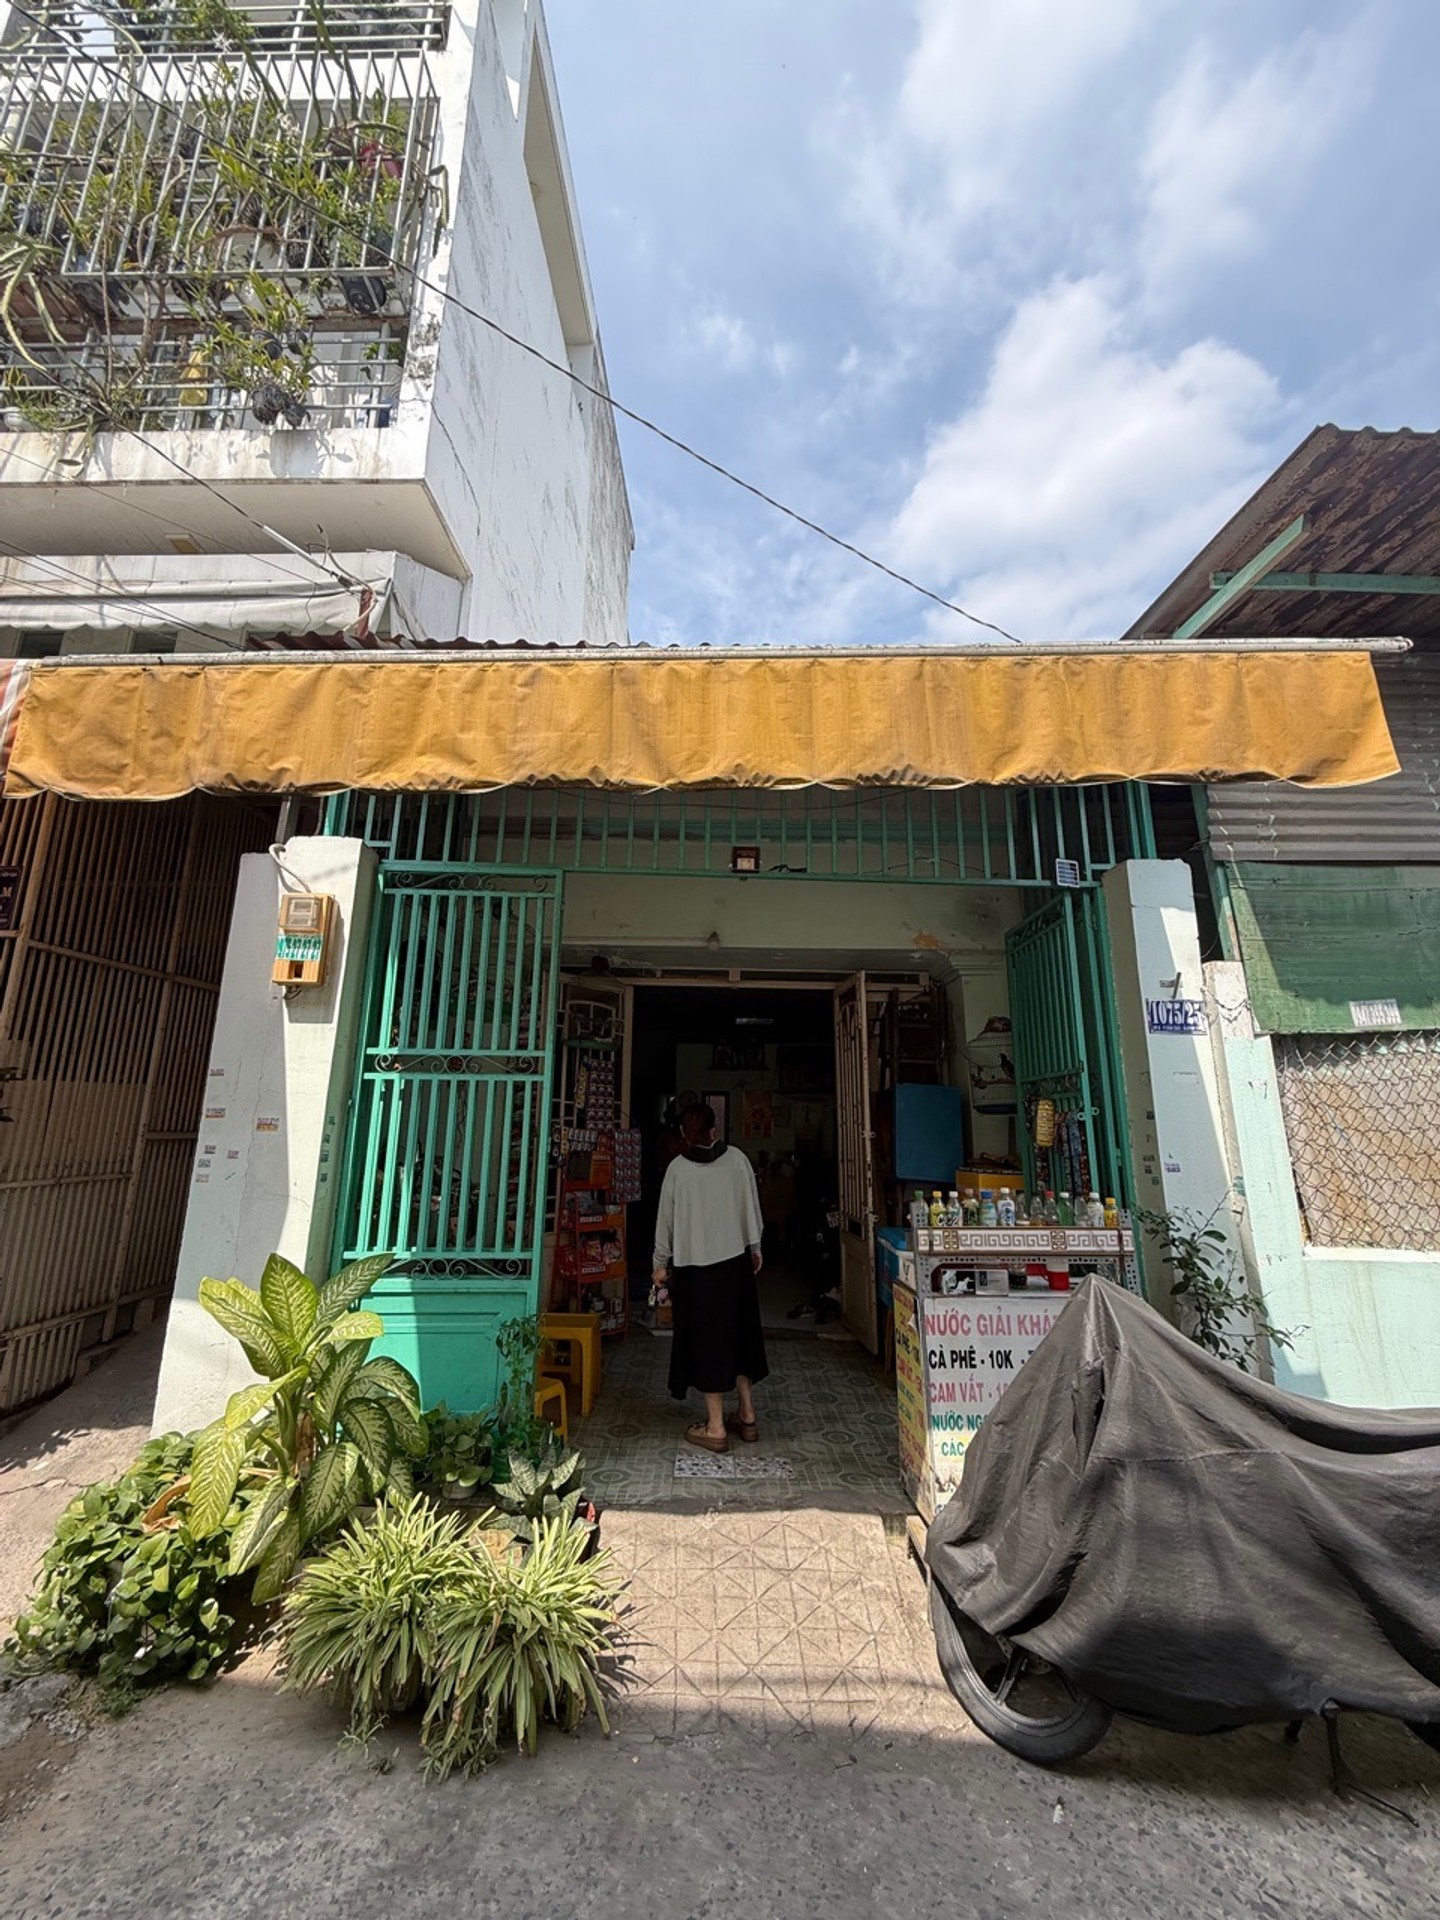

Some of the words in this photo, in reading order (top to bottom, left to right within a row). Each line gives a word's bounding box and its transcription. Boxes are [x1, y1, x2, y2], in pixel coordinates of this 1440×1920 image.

[925, 1307, 971, 1336] NƯỚC
[977, 1306, 1012, 1336] GIẢI
[1018, 1309, 1058, 1336] KHÁ
[928, 1344, 947, 1369] CÀ
[950, 1345, 977, 1369] PHÊ
[988, 1350, 1014, 1369] 10K
[928, 1382, 957, 1403] CAM
[932, 1410, 964, 1431] NƯỚC
[967, 1414, 988, 1431] NG
[941, 1438, 964, 1456] CÁC
